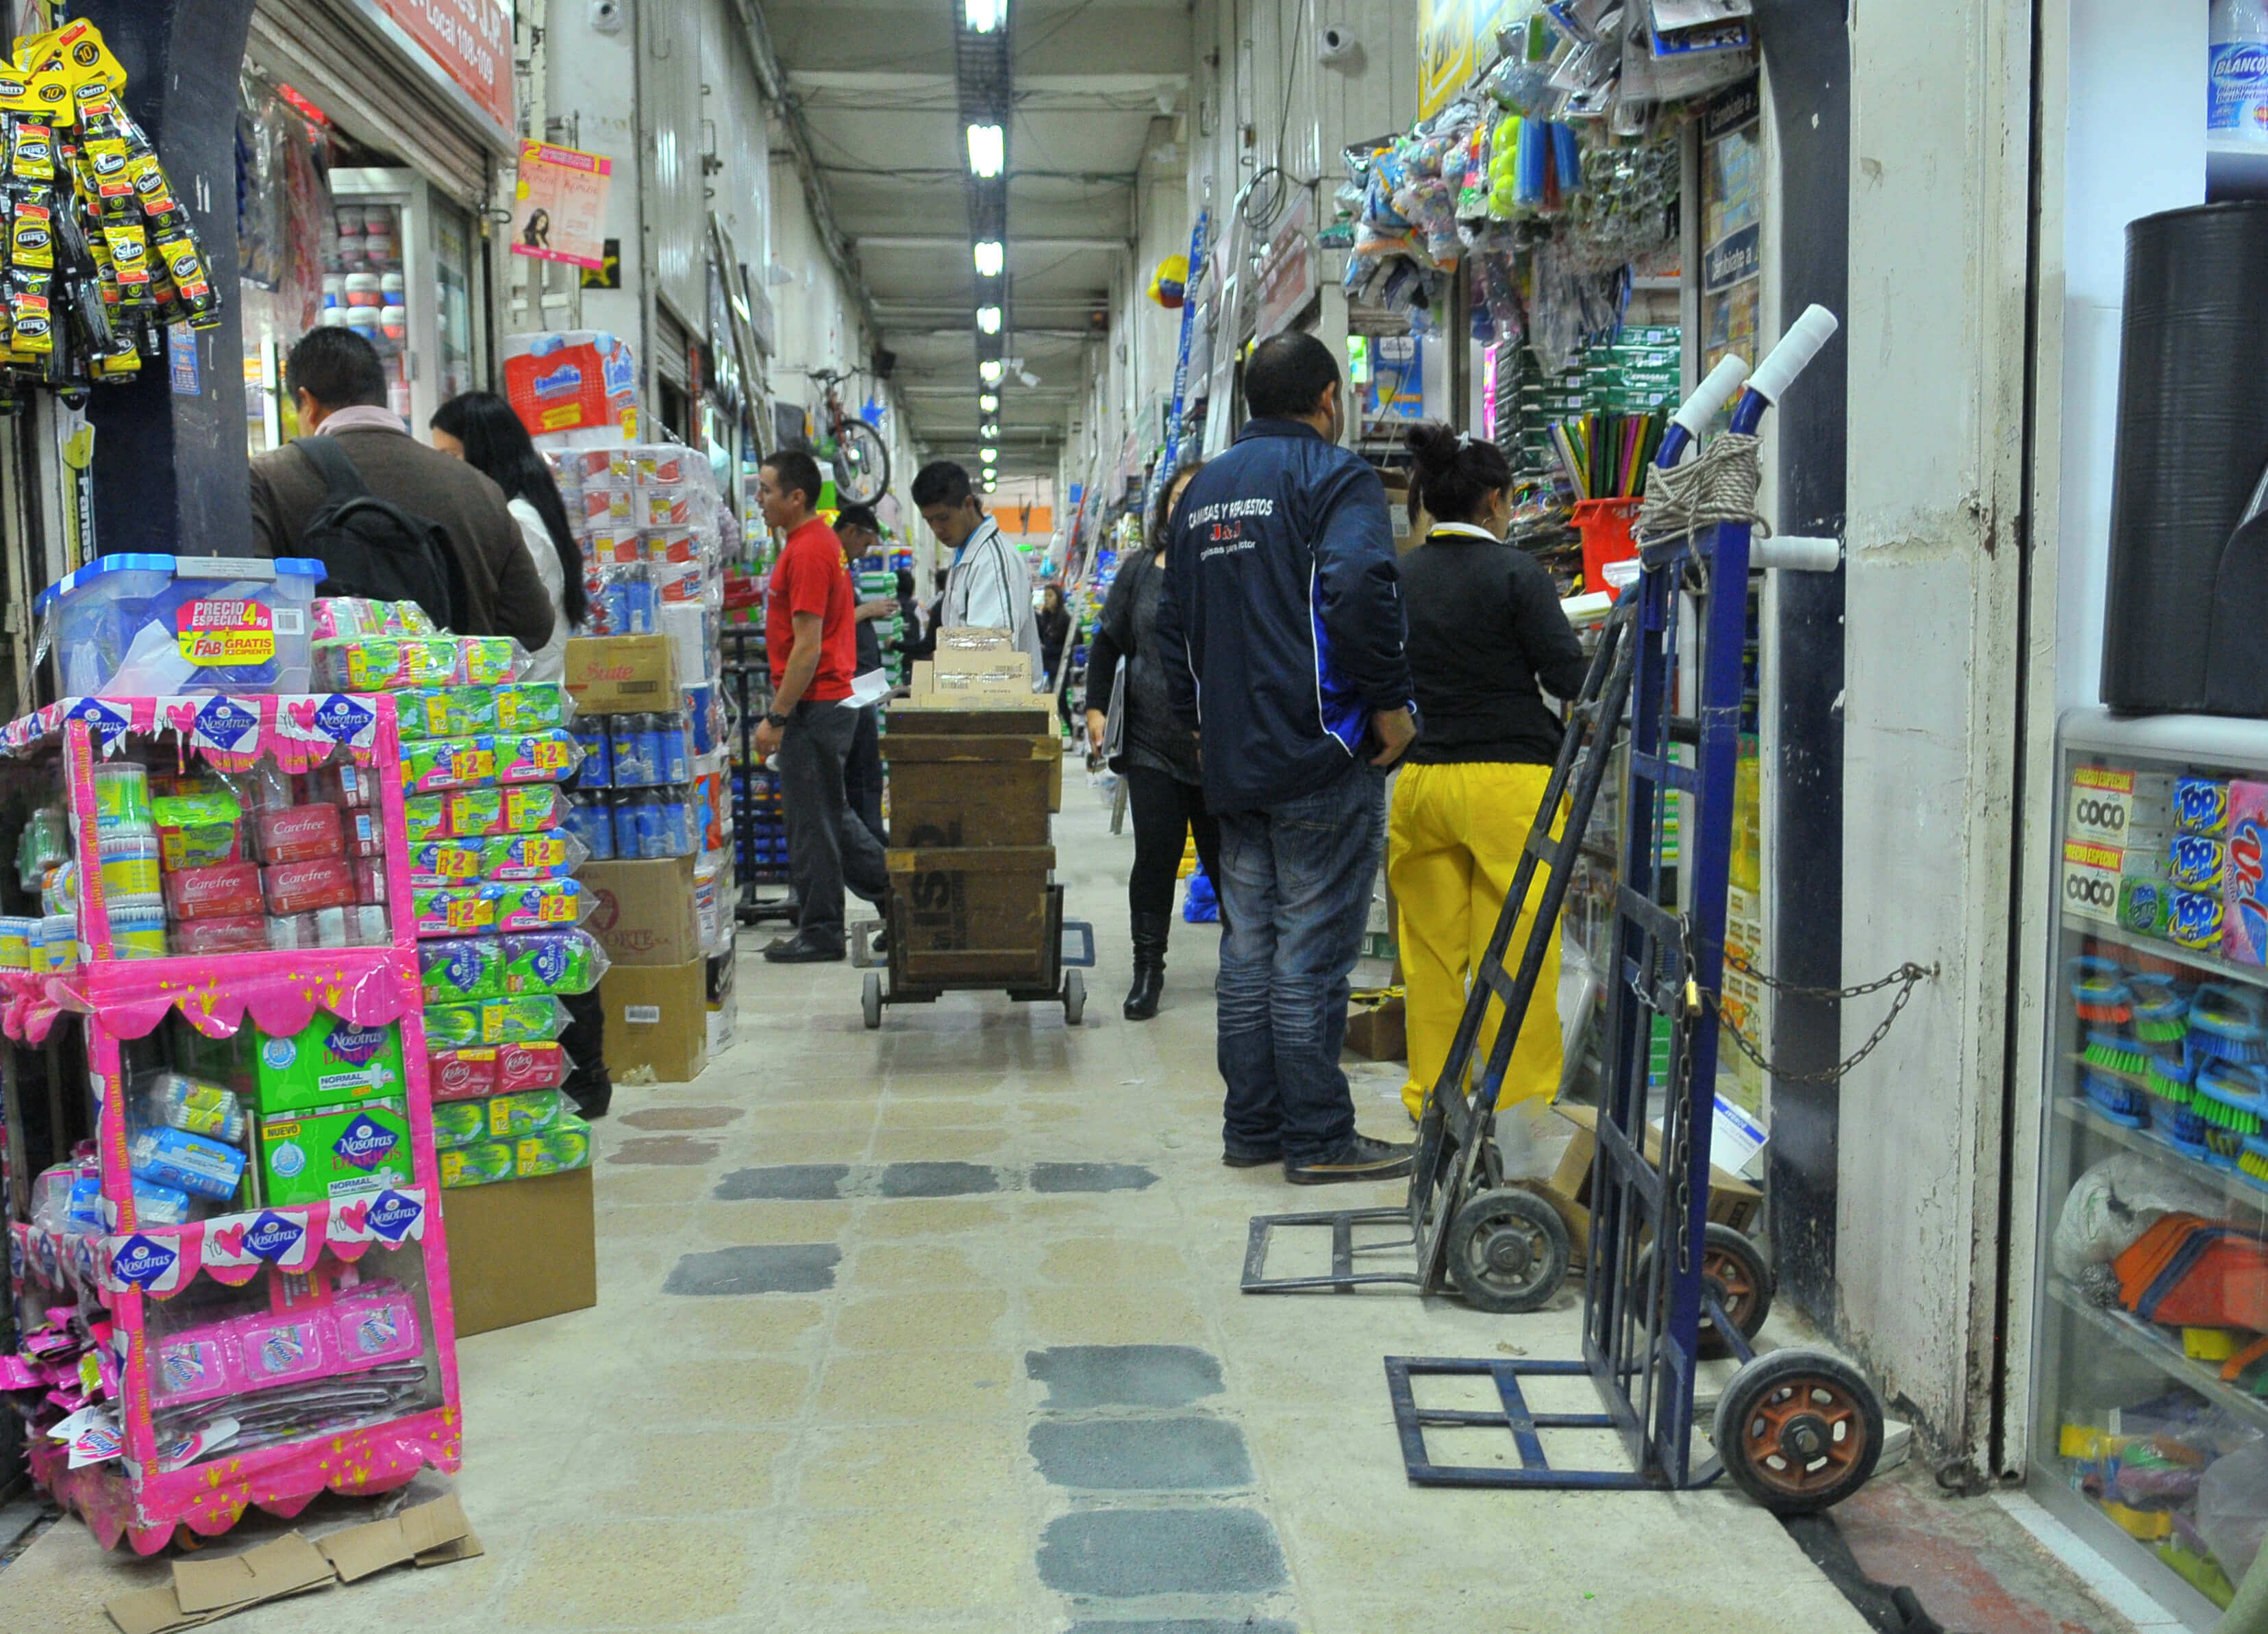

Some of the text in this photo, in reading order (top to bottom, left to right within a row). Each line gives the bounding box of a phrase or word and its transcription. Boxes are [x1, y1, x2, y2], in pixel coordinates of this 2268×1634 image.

[426, 0, 456, 47] Local
[79, 46, 92, 62] 10
[0, 84, 25, 95] herry
[45, 88, 60, 99] 10
[79, 85, 106, 99] Cherry
[139, 177, 160, 192] Cherry
[18, 232, 48, 244] Cherry
[176, 260, 197, 276] Cherry
[17, 320, 47, 331] Cherry
[1221, 503, 1229, 520] Y
[192, 615, 269, 627] ESPECIAL Kg
[194, 601, 258, 626] PRECIO 4
[193, 638, 272, 656] FAB GRATIS
[199, 714, 251, 733] Nosotras
[319, 712, 369, 727] Nosotras
[546, 744, 557, 763] 2
[466, 754, 478, 773] 2
[2076, 797, 2125, 831] COCO
[274, 819, 325, 835] Carefree
[539, 842, 550, 859] 2
[169, 857, 186, 868] 12
[452, 852, 465, 870] 2
[185, 877, 240, 890] Carefree
[278, 870, 332, 885] Carefree
[2067, 873, 2115, 907] COCO
[462, 901, 474, 920] 2
[553, 897, 564, 916] 2
[544, 943, 556, 981] Nosotras
[332, 1032, 383, 1048] Nosotras
[321, 1073, 363, 1085] NORMAL
[267, 1125, 298, 1137] NUEVO
[340, 1134, 393, 1153] Nosotras
[329, 1177, 373, 1190] NORMAL
[369, 1207, 416, 1226] Nosotras
[247, 1228, 298, 1248] Nosotras
[114, 1253, 171, 1277] Nosotras
[266, 1337, 294, 1364] Vanish
[166, 1355, 194, 1383] Vanish
